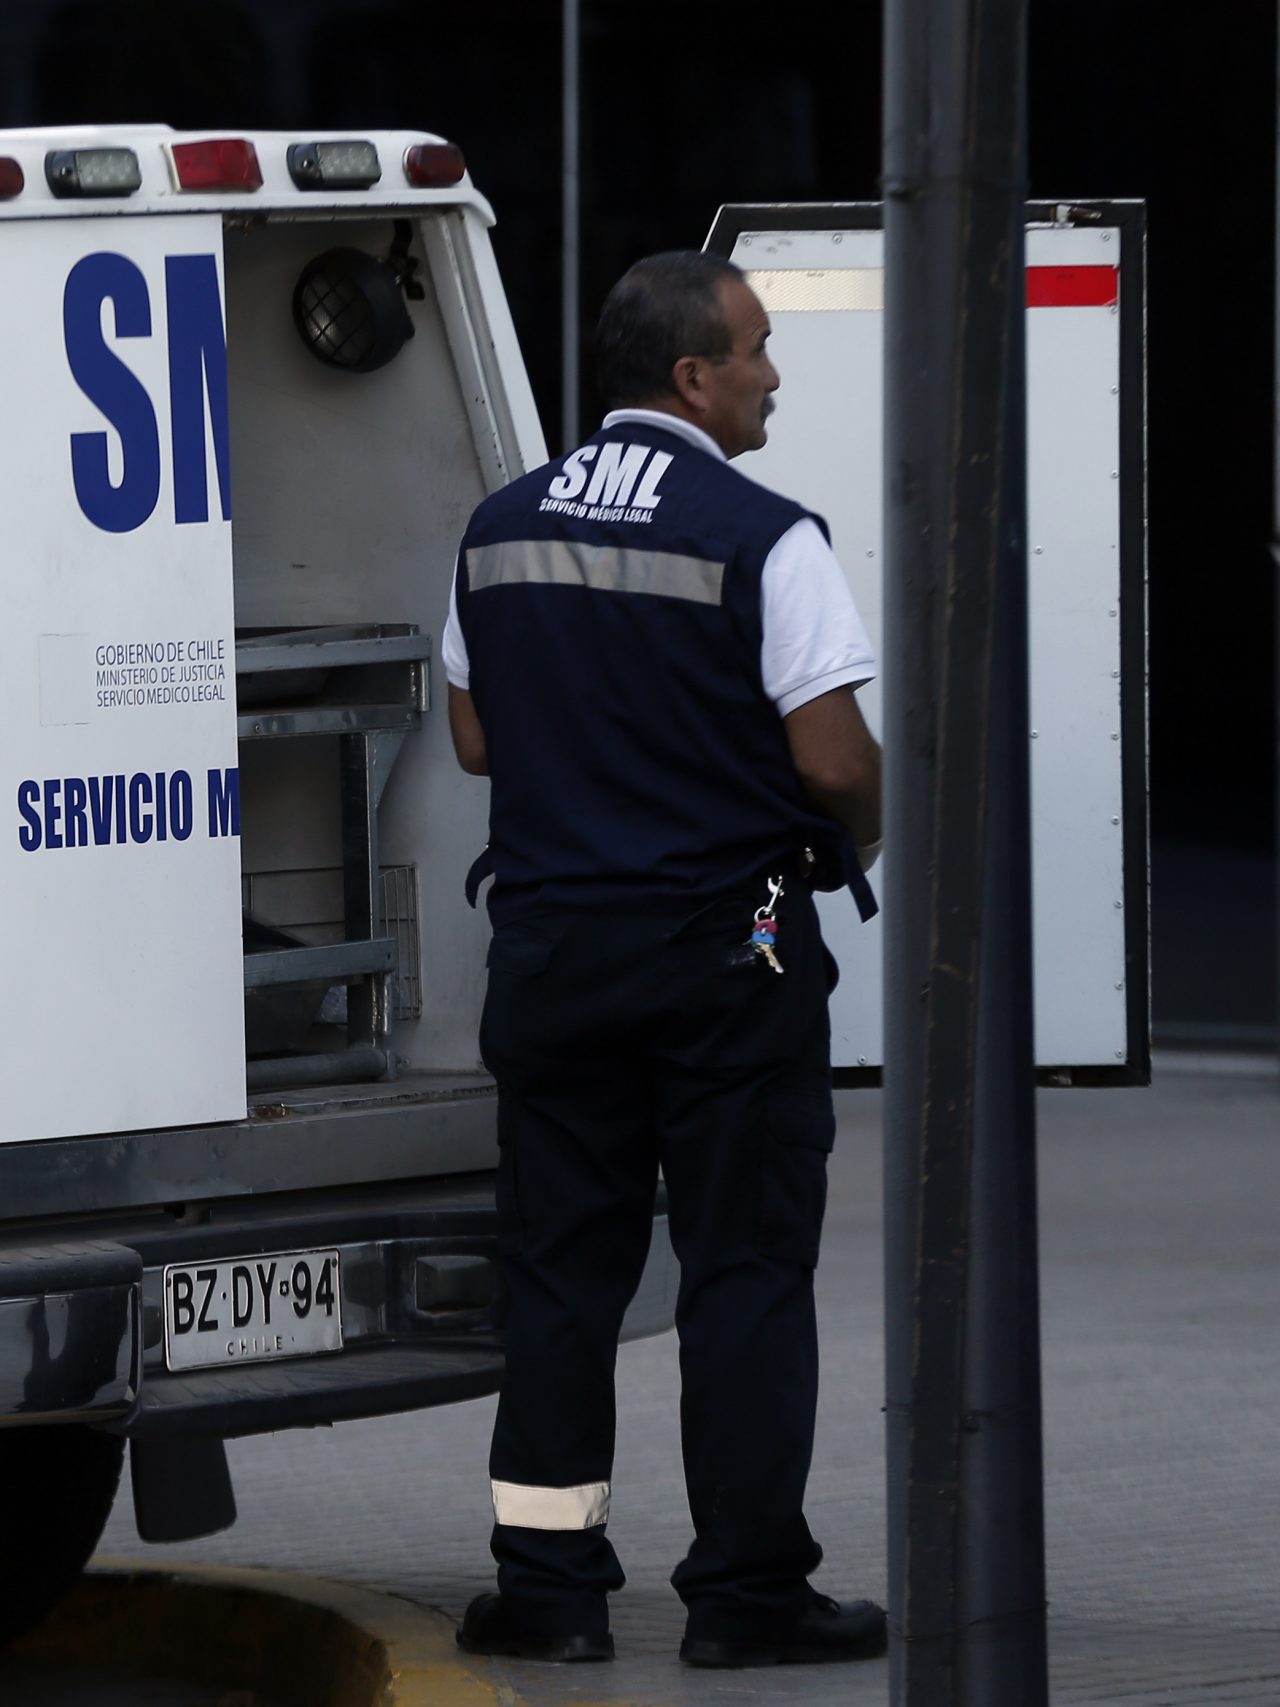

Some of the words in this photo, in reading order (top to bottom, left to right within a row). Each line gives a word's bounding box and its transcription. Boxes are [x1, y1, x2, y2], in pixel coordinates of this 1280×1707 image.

[548, 442, 675, 509] SML
[539, 498, 588, 518] SERVICIO
[623, 508, 653, 523] LEGAL
[96, 643, 165, 666] GOBIERNO
[167, 642, 185, 662] DE
[188, 639, 225, 661] CHILE
[96, 667, 158, 686] MINISTERIO
[161, 666, 176, 683] DE
[178, 664, 225, 682] JUSTICIA
[97, 688, 146, 707] SERVICIO
[146, 686, 190, 704] MEDICO
[191, 684, 225, 702] LEGAL
[17, 769, 193, 852] SERVICIO
[225, 1335, 283, 1356] CHILE
